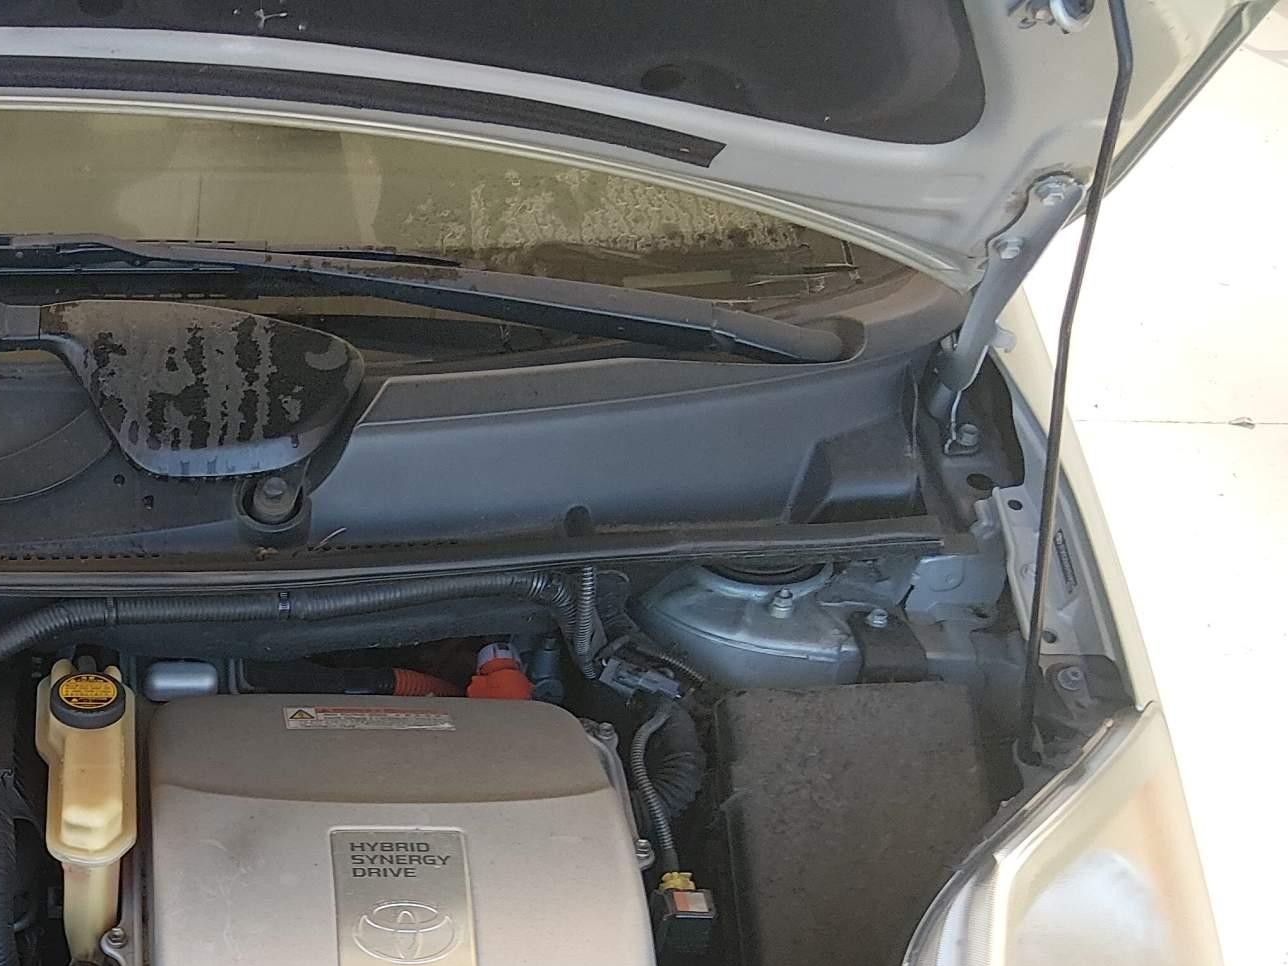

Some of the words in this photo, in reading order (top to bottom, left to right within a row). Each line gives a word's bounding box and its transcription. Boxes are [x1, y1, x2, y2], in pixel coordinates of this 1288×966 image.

[349, 842, 430, 852] HYBRID
[351, 854, 451, 866] SYNERGY
[351, 867, 417, 878] DRIVE
